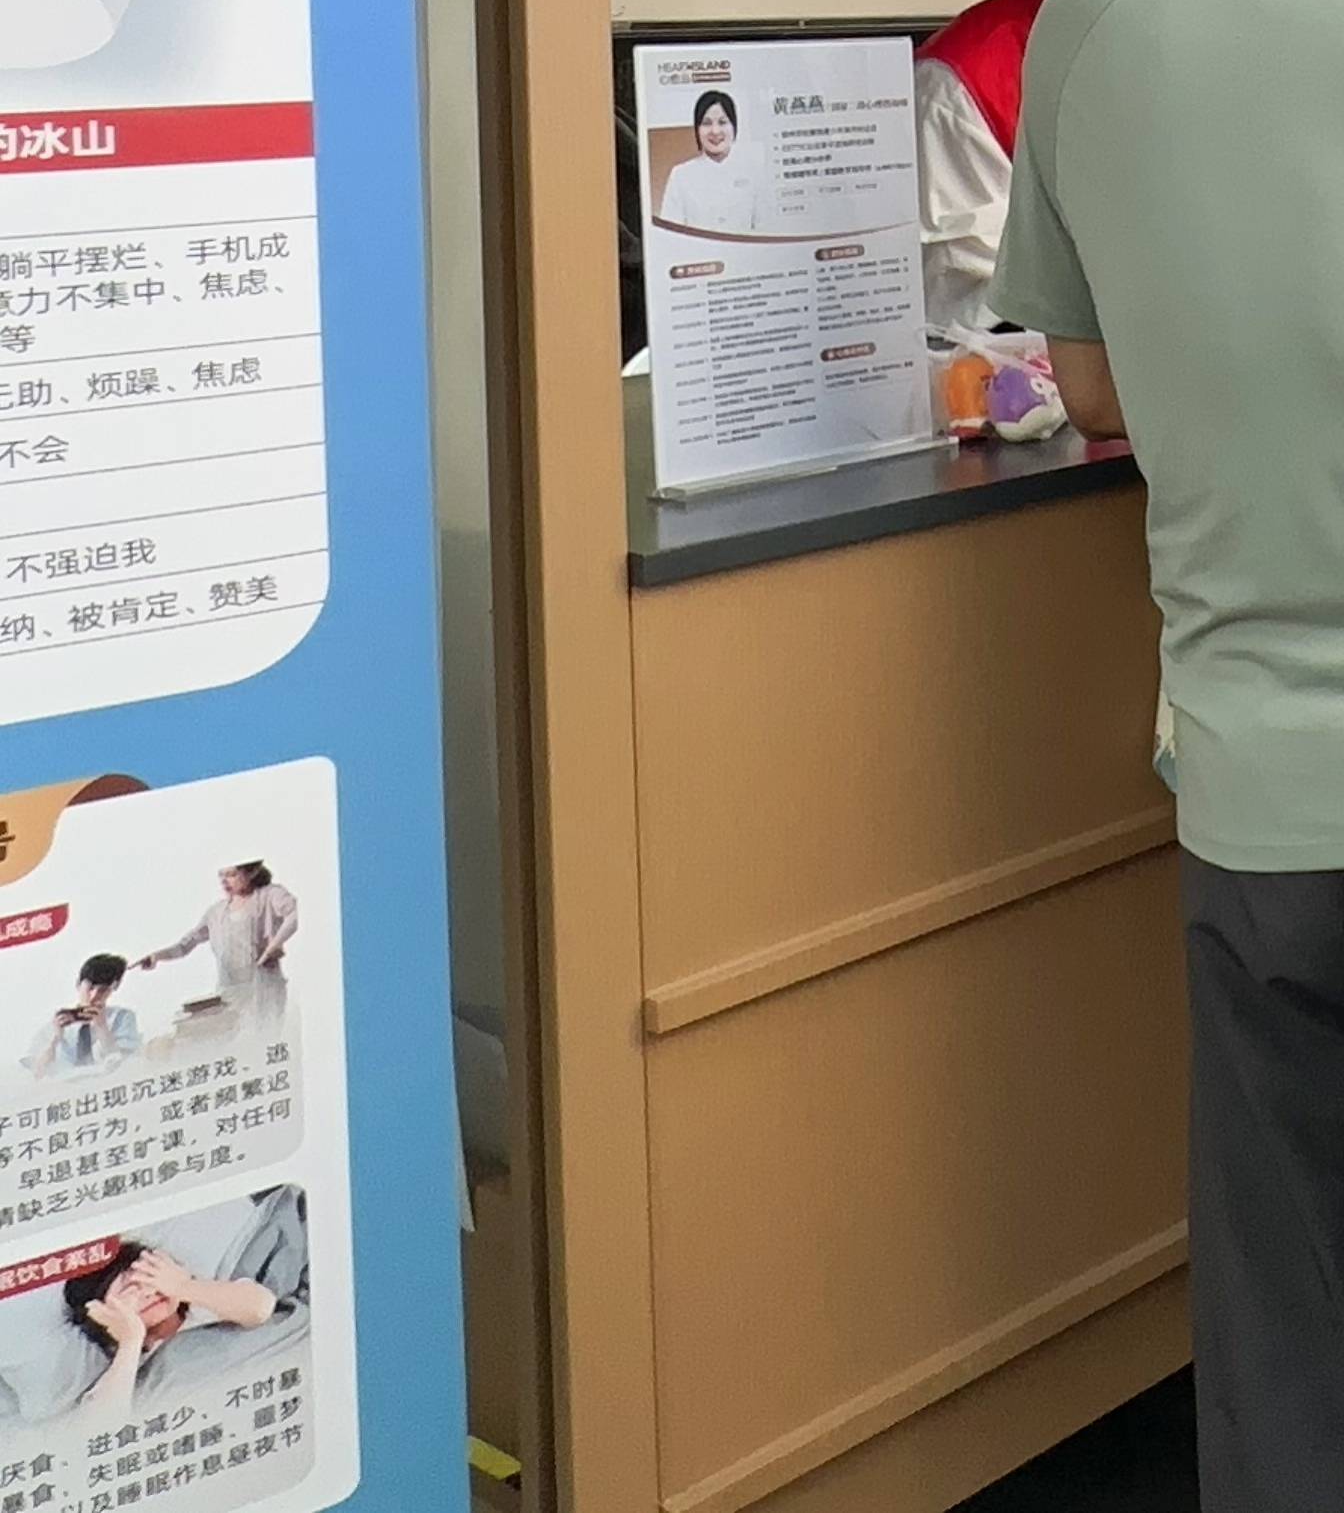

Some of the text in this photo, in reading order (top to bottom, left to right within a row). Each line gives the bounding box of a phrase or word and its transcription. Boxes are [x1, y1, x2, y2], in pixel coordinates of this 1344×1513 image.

[1, 325, 36, 354] 等
[0, 434, 70, 469] 不会
[6, 537, 157, 584] 不强迫我
